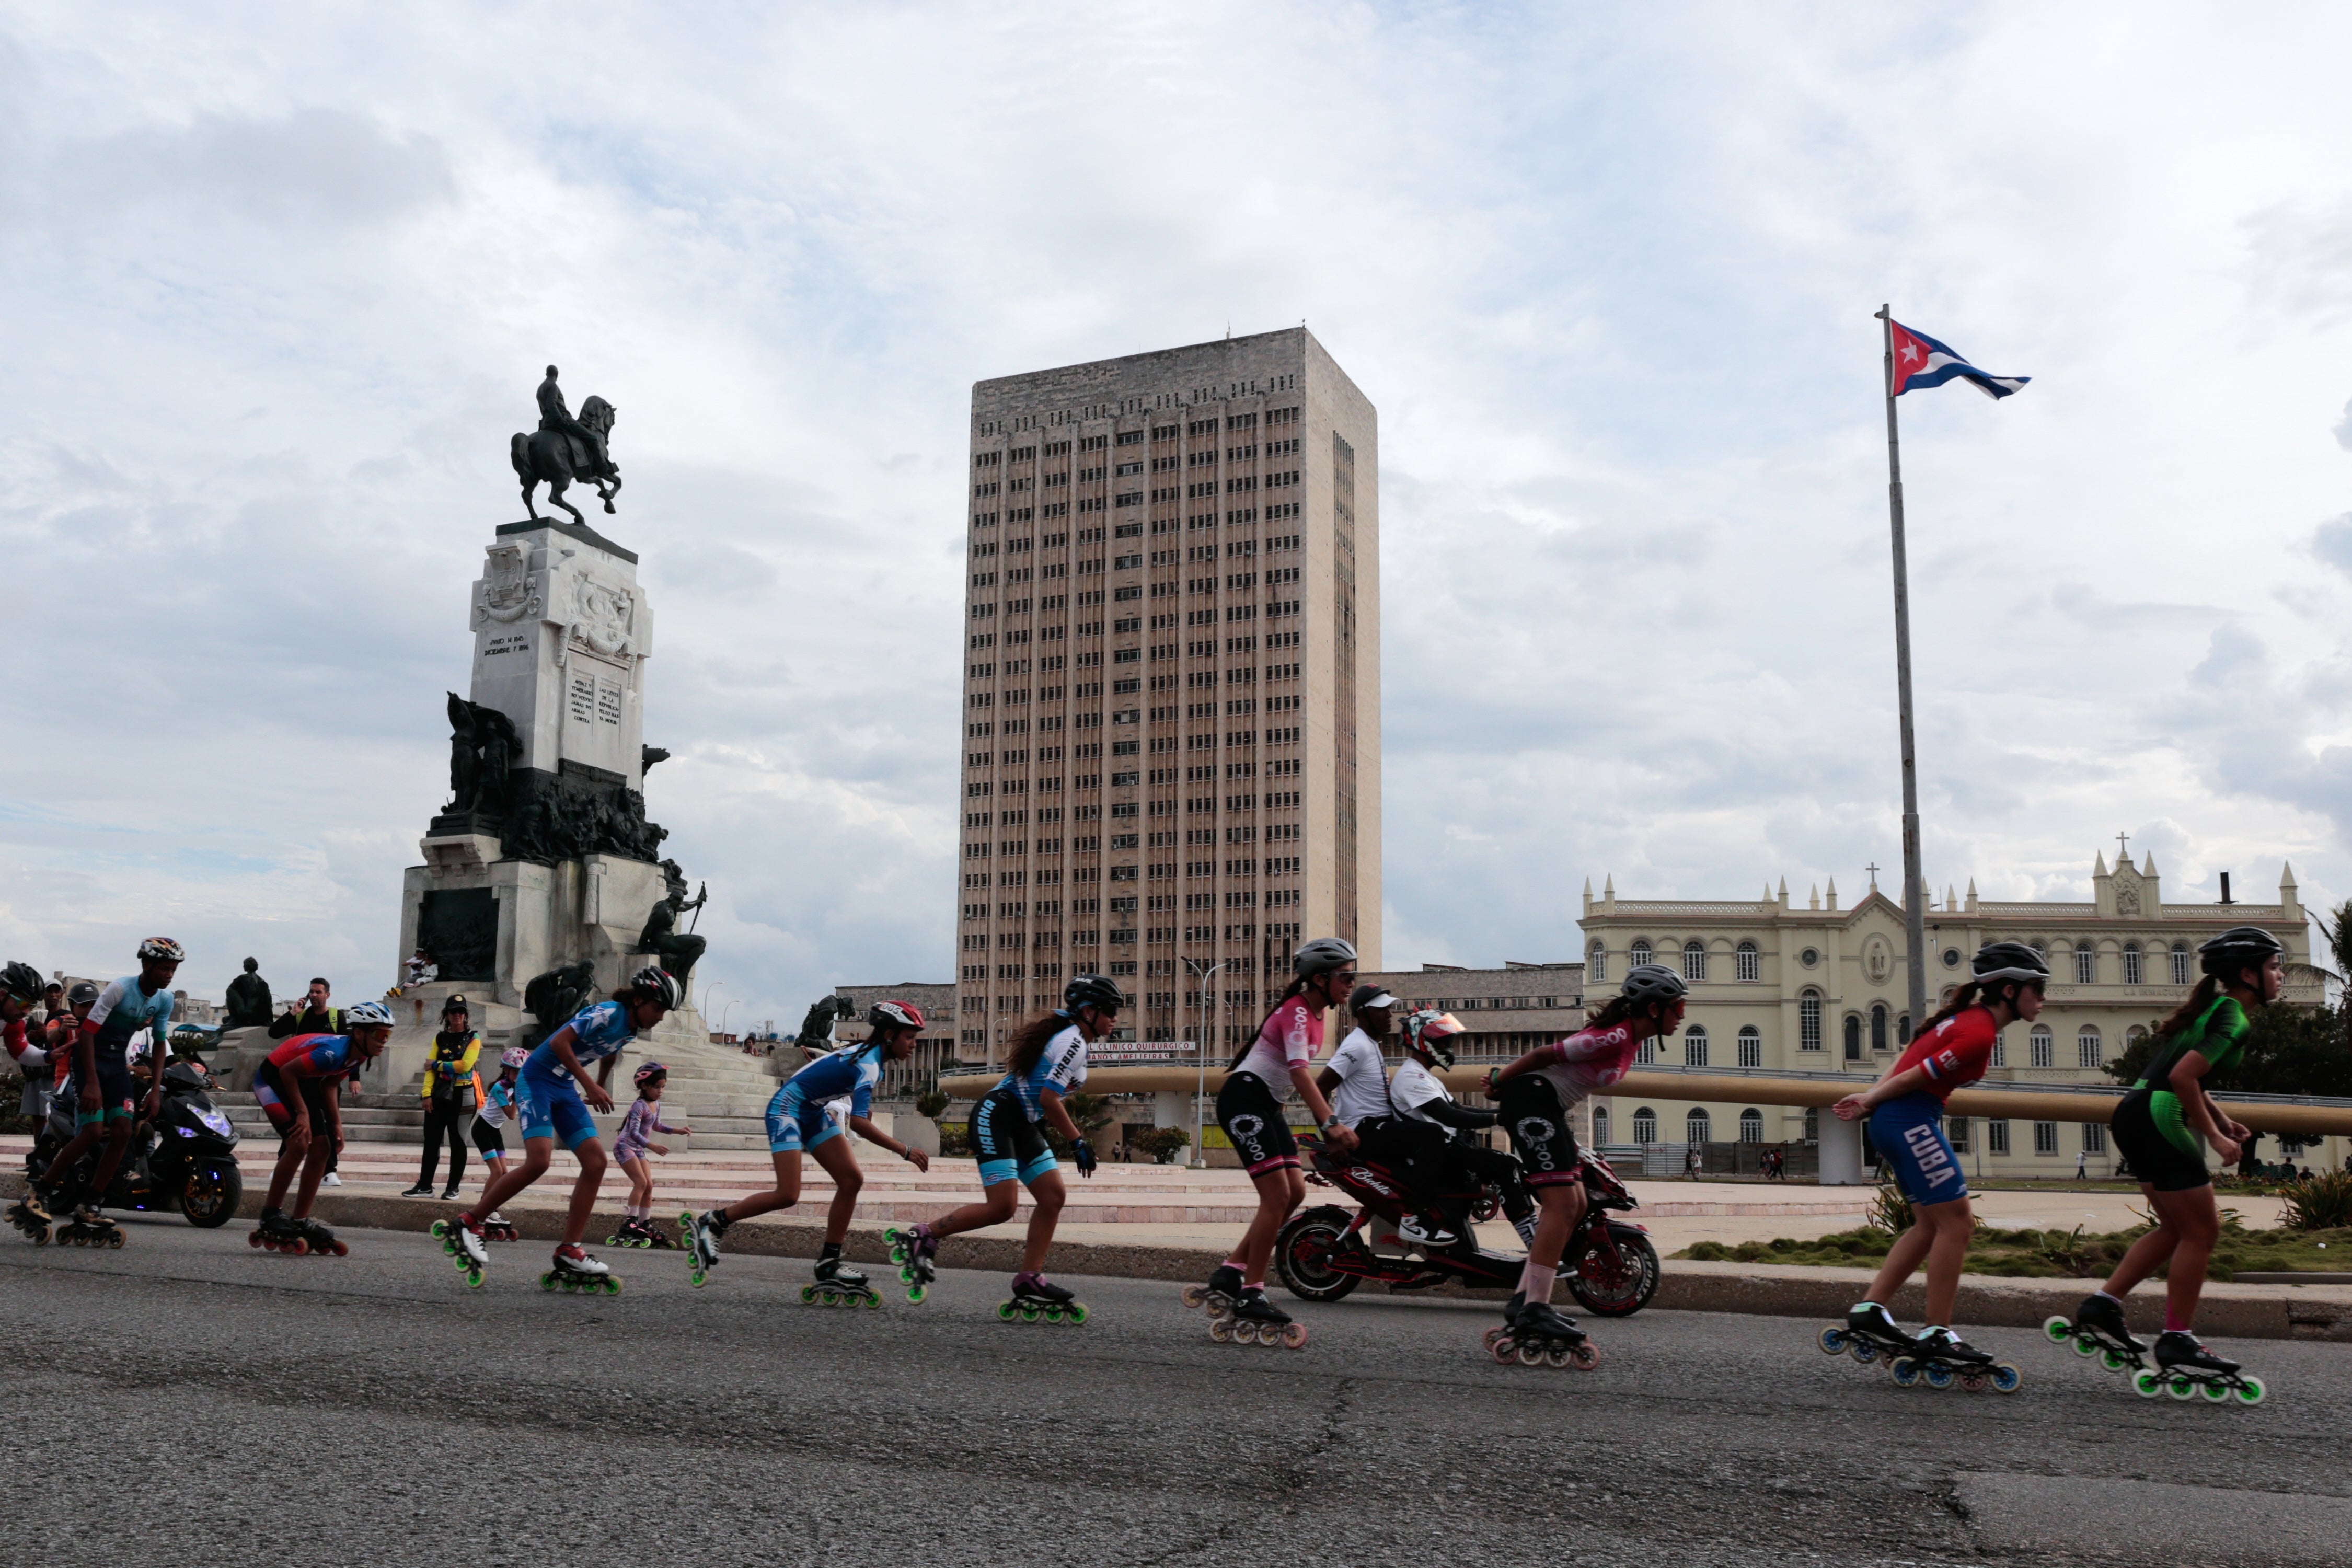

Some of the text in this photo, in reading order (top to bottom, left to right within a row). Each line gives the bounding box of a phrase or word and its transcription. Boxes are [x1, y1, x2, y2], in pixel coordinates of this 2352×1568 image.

[485, 647, 510, 656] DICIEMBRE
[883, 1004, 901, 1014] 005
[1053, 1037, 1082, 1079] HABANA
[977, 1099, 997, 1155] HABANA
[1903, 1124, 1956, 1189] CUBA
